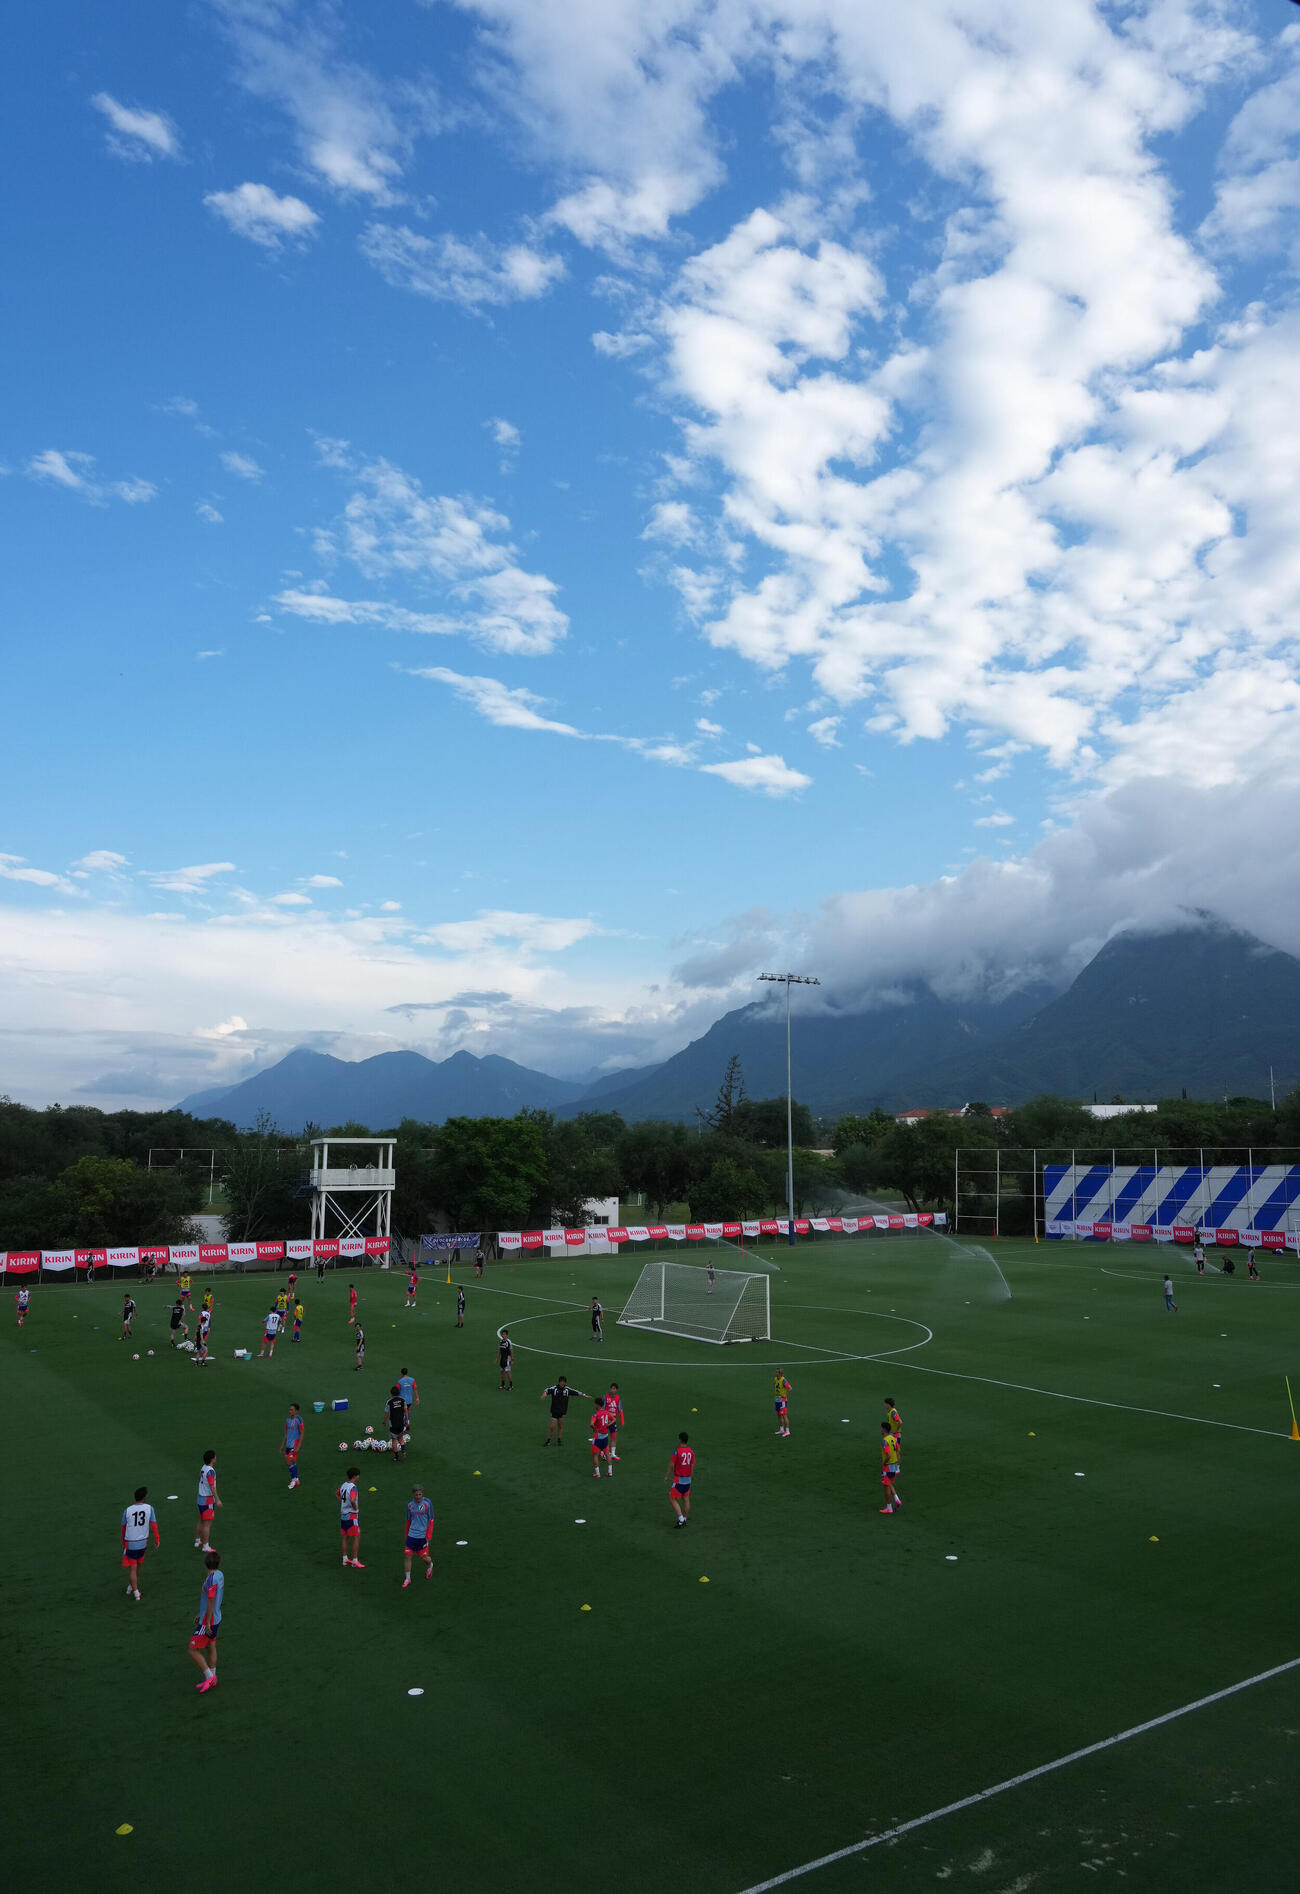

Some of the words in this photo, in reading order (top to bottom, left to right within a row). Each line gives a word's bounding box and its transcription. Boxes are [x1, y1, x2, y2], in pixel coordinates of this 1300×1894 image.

[523, 1235, 542, 1243] KIRIN
[1240, 1233, 1260, 1241] KIRIN
[1263, 1235, 1284, 1243] KIRIN
[259, 1245, 282, 1254] KIRIN
[288, 1245, 311, 1253] KIRIN
[315, 1243, 338, 1252] KIRIN
[341, 1242, 363, 1250] KIRIN
[367, 1241, 388, 1249] KIRIN
[172, 1249, 197, 1258] KIRIN
[201, 1248, 226, 1257] KIRIN
[230, 1247, 255, 1255] KIRIN
[45, 1255, 72, 1264] KIRIN
[77, 1253, 105, 1262] KIIN
[110, 1252, 136, 1260] KIRIN
[9, 1257, 38, 1266] KIRIN
[600, 1414, 608, 1426] 14
[681, 1452, 692, 1466] 20
[132, 1510, 146, 1527] 13
